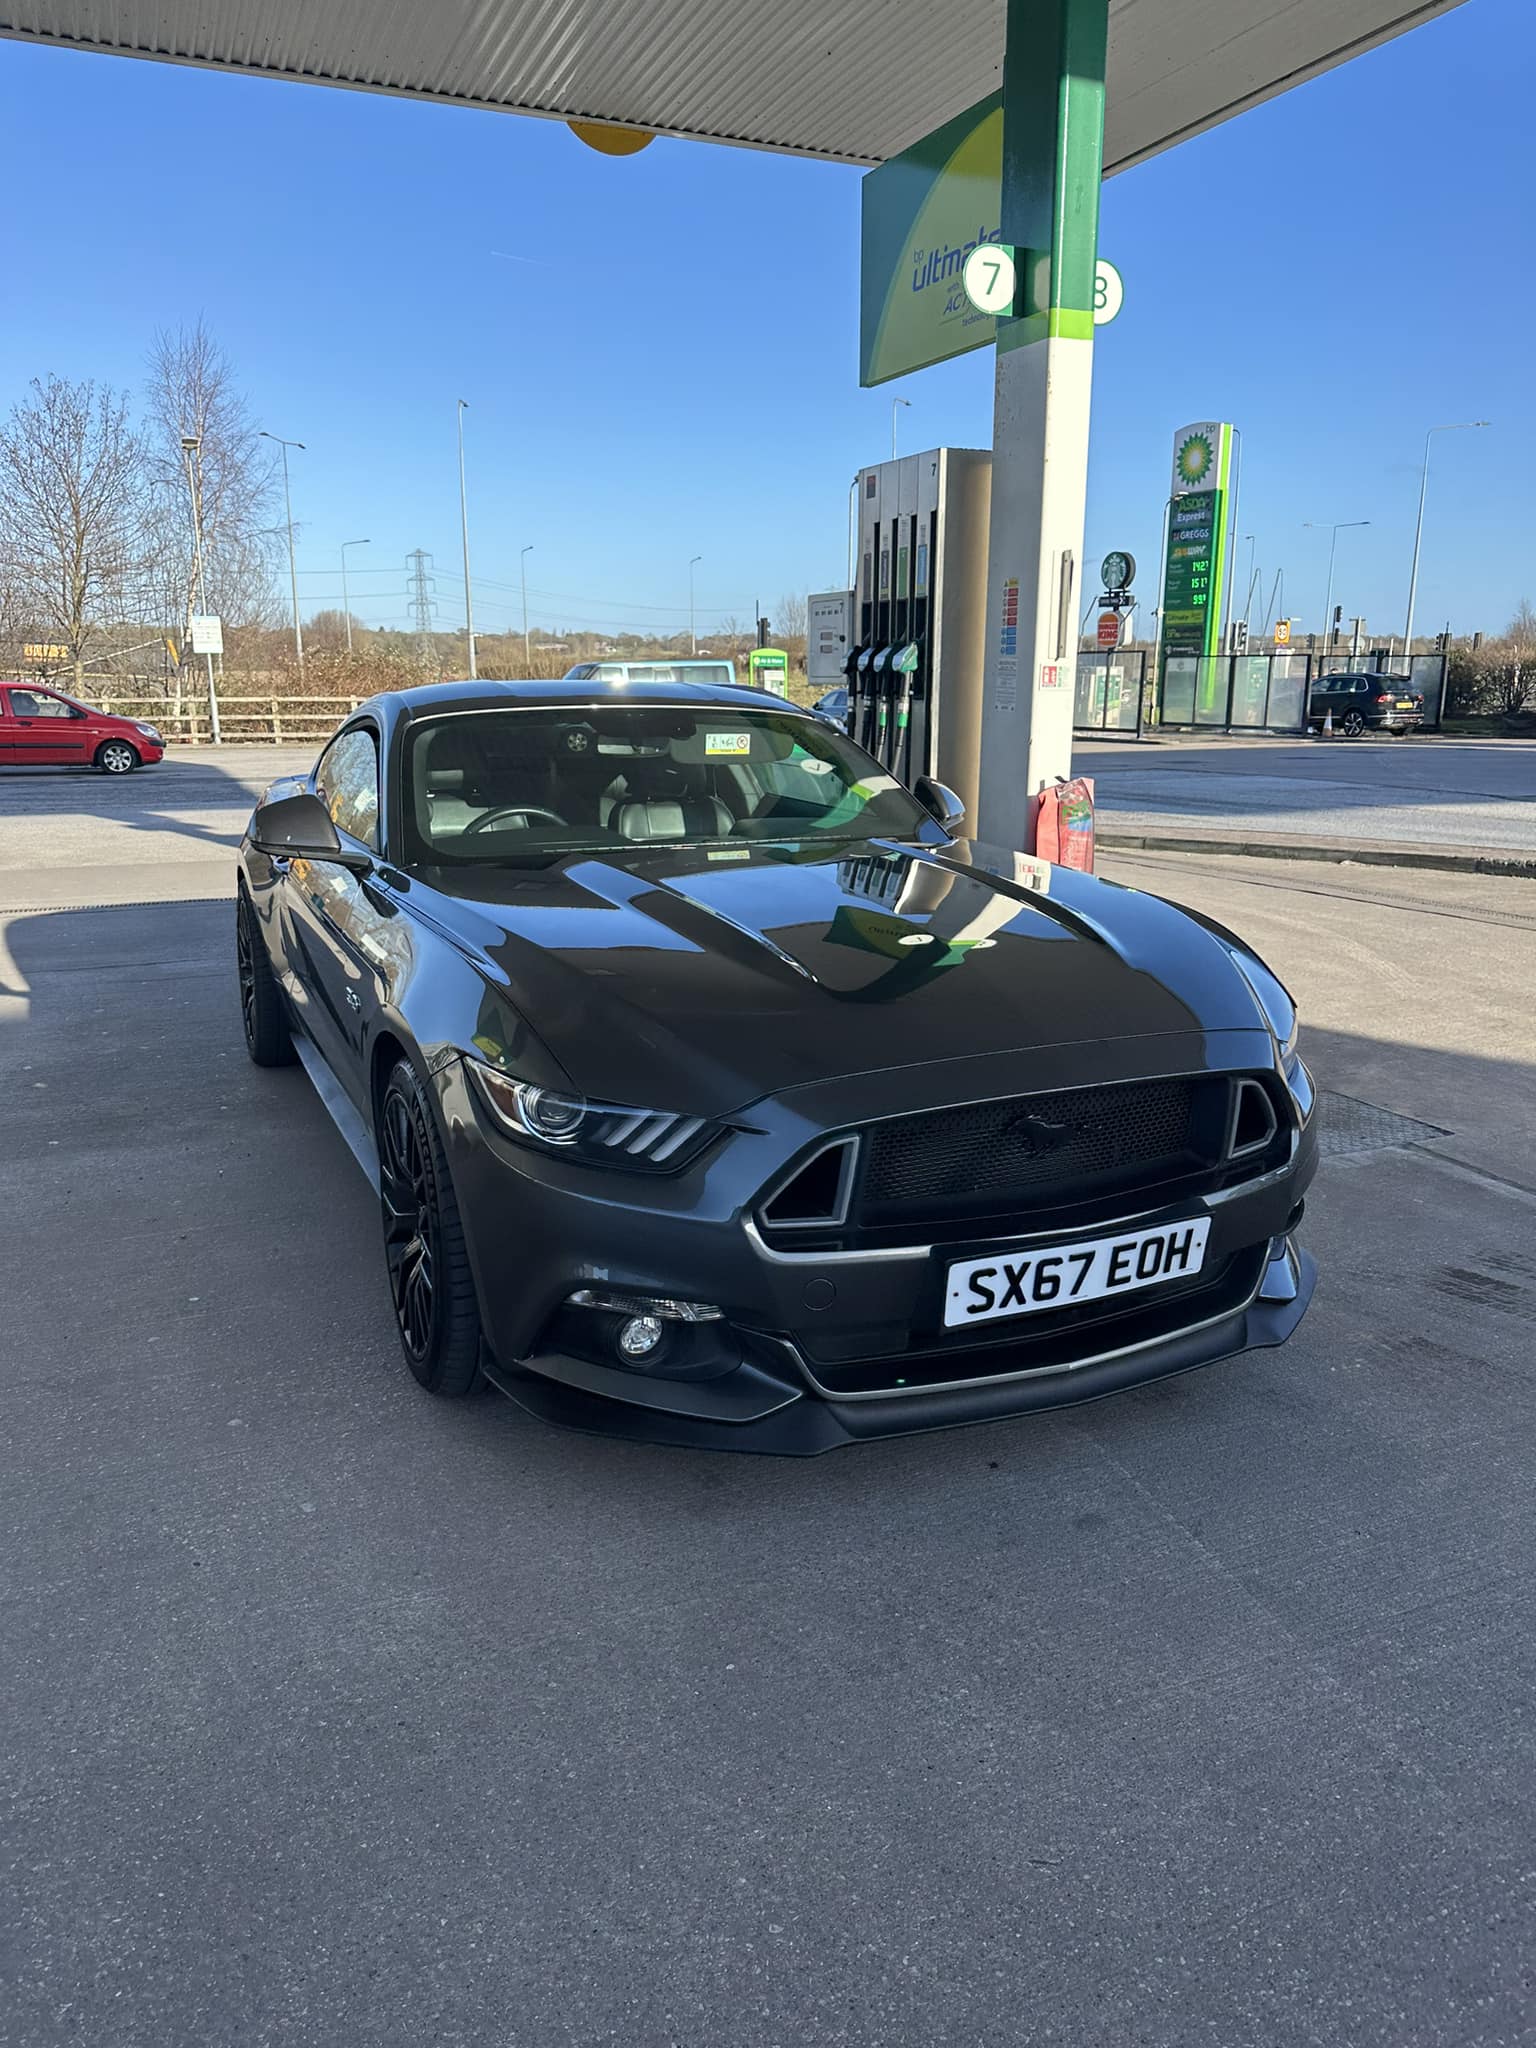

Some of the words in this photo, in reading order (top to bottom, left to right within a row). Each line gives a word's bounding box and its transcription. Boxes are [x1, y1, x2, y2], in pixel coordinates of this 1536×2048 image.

[982, 262, 1000, 295] 7
[930, 463, 937, 477] 7
[1178, 497, 1206, 511] ASDA
[1177, 511, 1205, 522] Express
[1180, 528, 1209, 540] GREGGS
[1099, 631, 1118, 639] KING
[966, 1250, 1096, 1314] SX67
[1106, 1228, 1194, 1288] EOH
